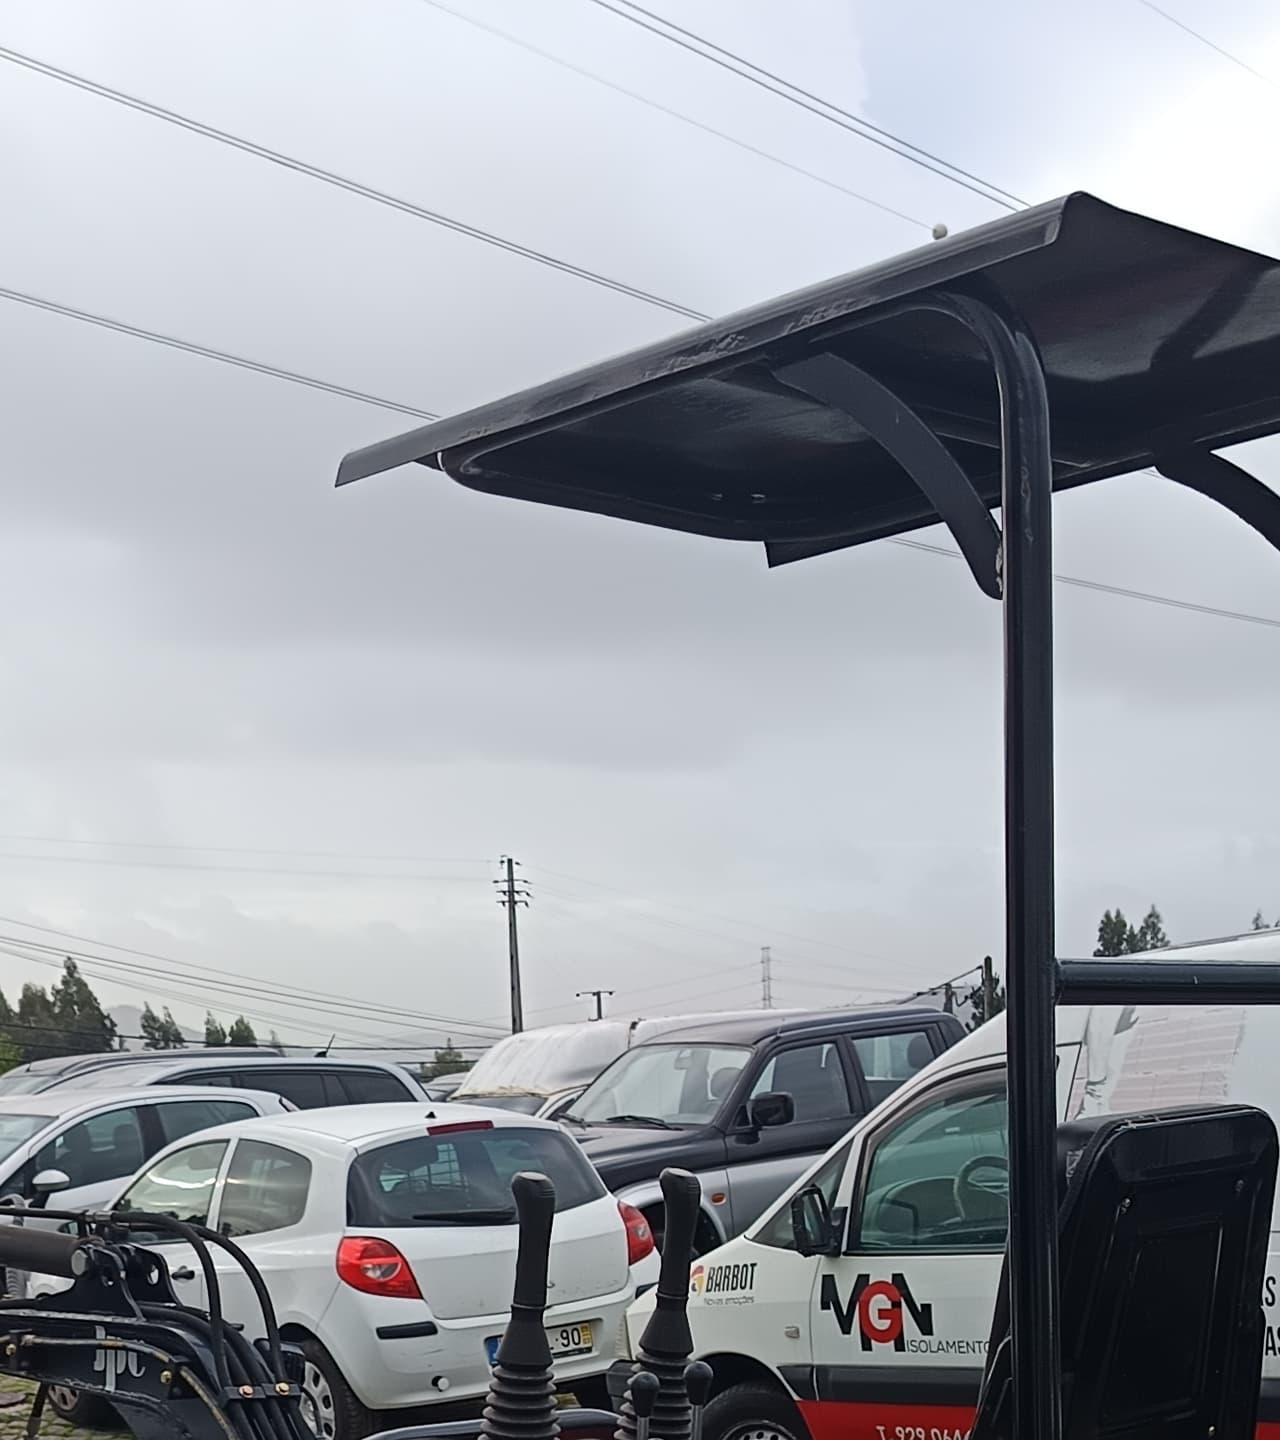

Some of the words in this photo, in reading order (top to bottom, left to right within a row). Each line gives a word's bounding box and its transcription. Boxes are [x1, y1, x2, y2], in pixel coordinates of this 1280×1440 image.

[705, 1262, 758, 1293] BARBOT
[1265, 1275, 1276, 1307] S
[820, 1273, 934, 1352] MGN
